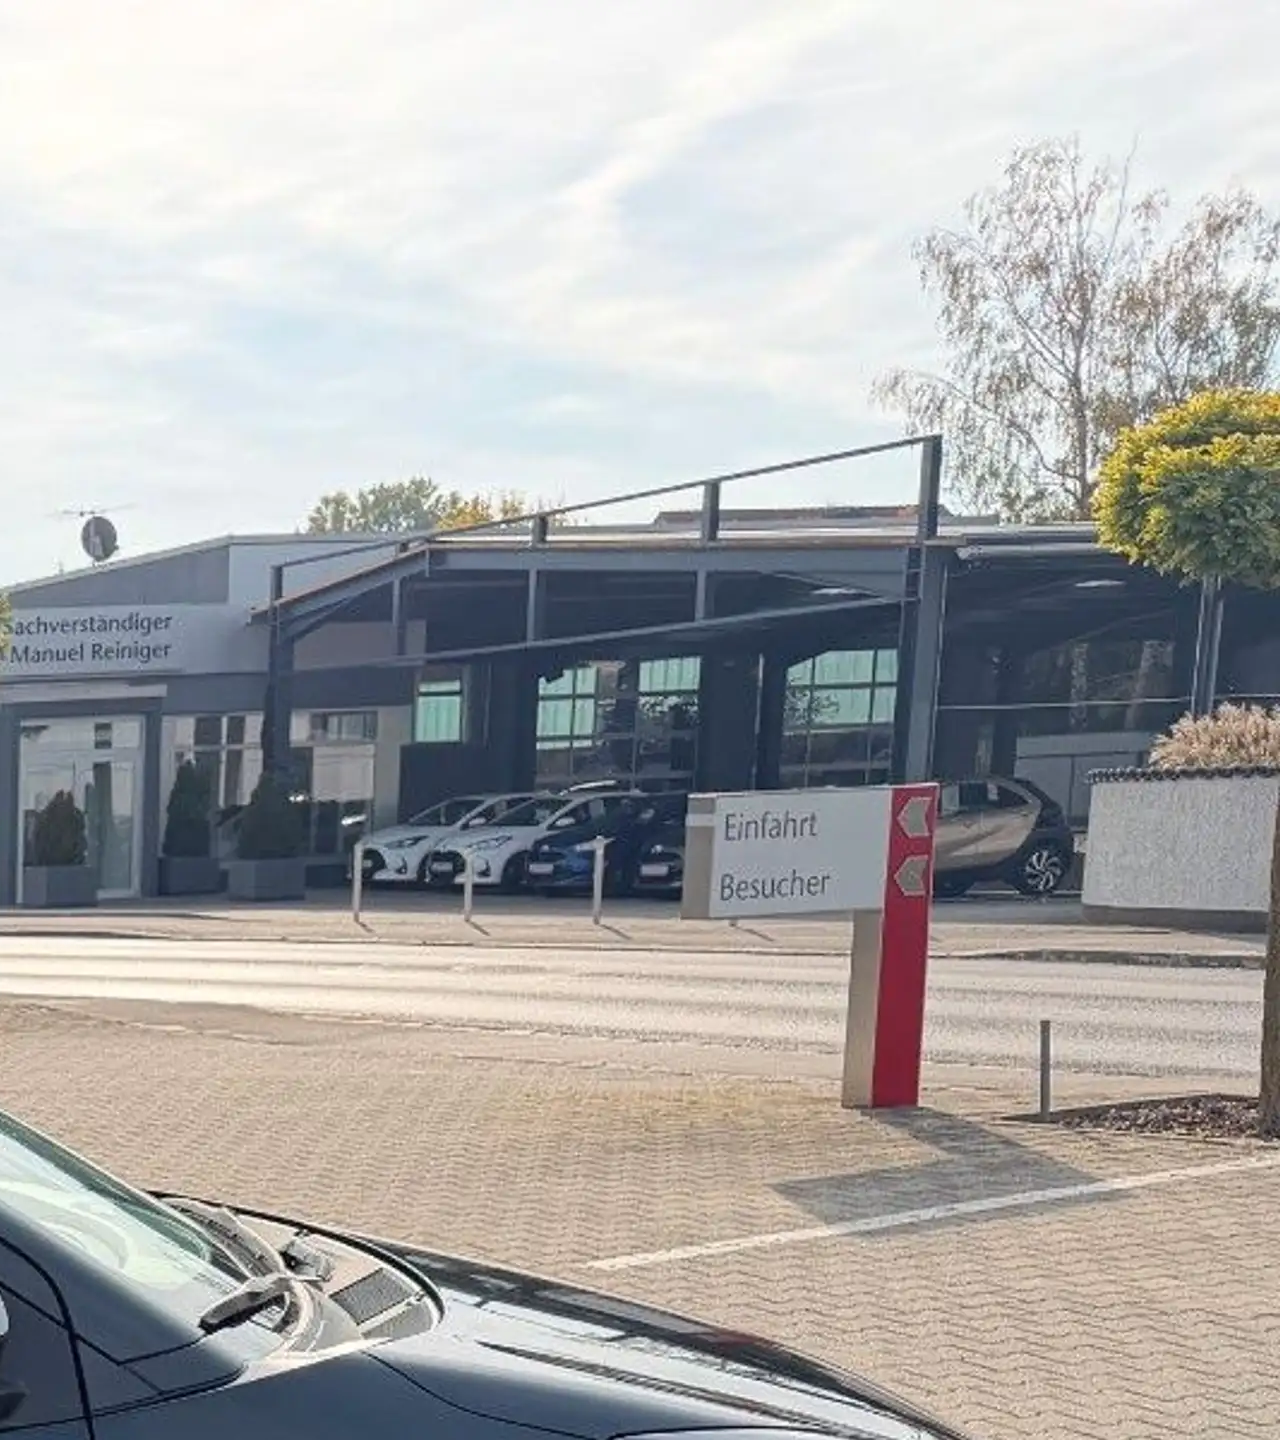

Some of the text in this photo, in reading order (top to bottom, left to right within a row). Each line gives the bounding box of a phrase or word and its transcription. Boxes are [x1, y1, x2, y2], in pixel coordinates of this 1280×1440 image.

[10, 640, 171, 664] Manuel Reiniger
[724, 810, 819, 842] Einfahrt
[720, 869, 831, 901] Besucher
